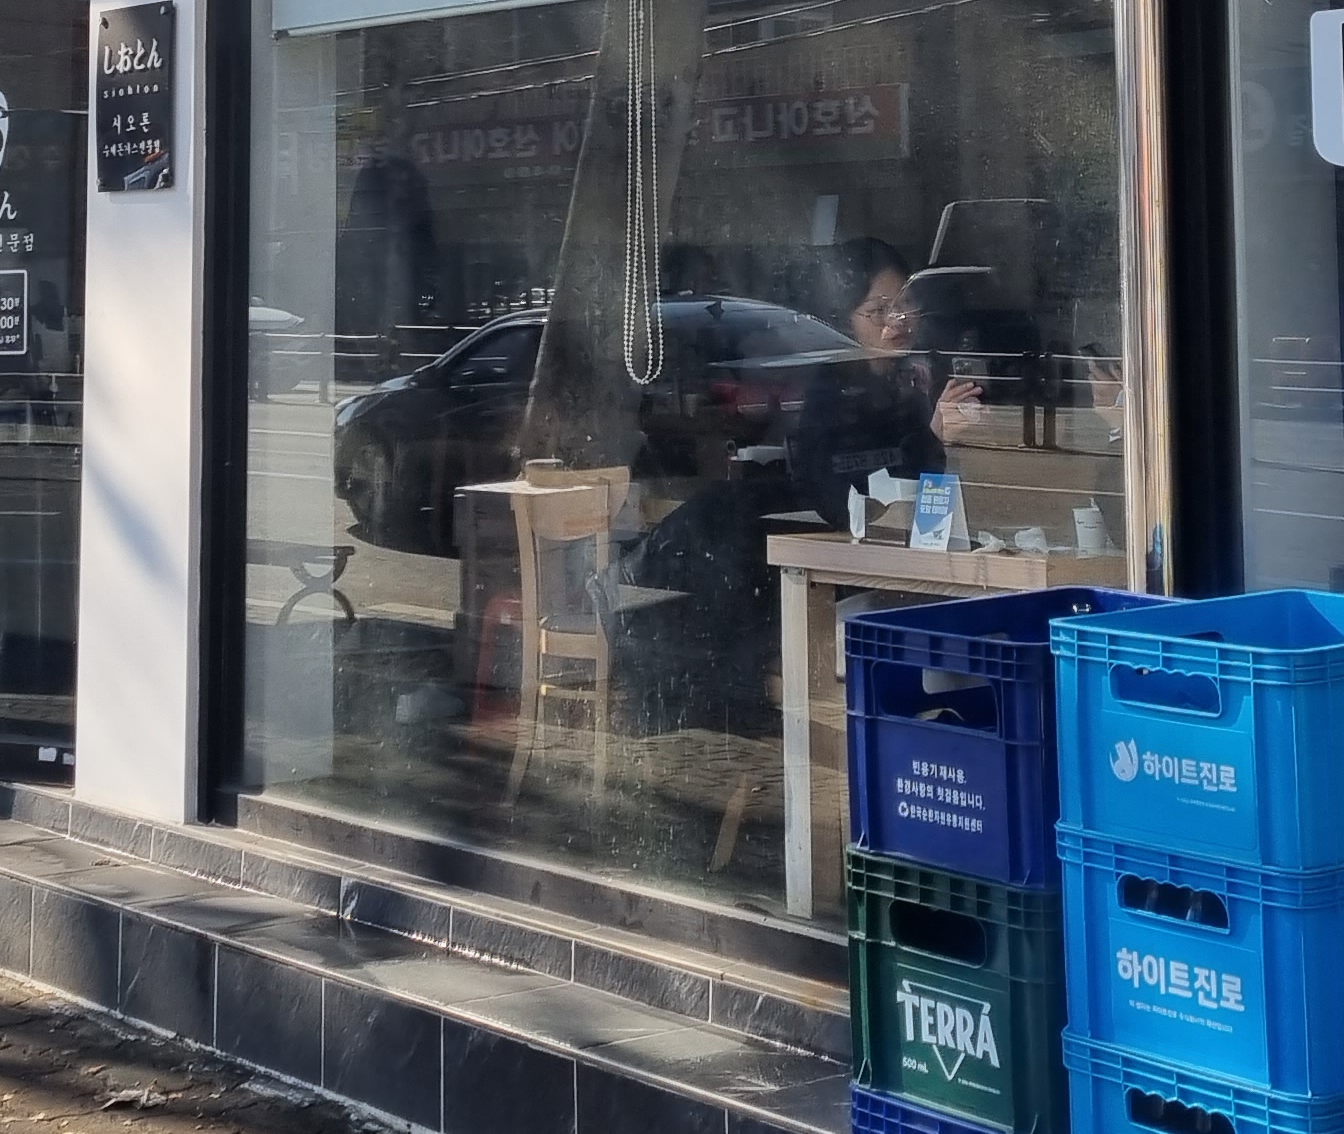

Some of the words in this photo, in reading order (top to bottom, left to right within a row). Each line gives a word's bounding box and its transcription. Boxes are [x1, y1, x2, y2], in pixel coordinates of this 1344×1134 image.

[103, 38, 163, 75] しおとん
[897, 777, 934, 799] 환경사랑의
[912, 760, 937, 779] 빈용기
[1142, 751, 1237, 792] 하이트진로
[1116, 947, 1245, 1012] 하이트진로
[896, 989, 1000, 1069] TERRA
